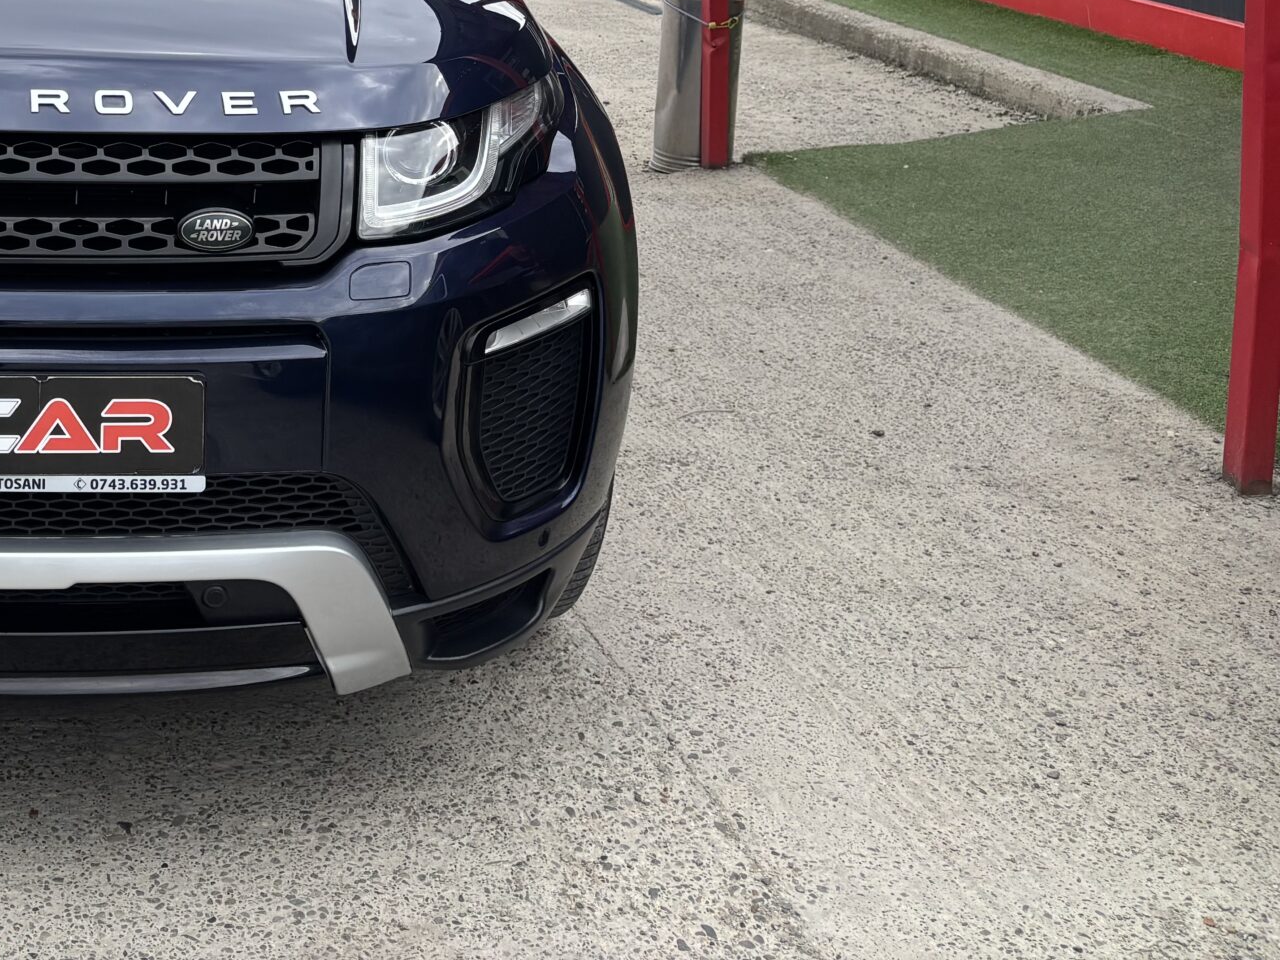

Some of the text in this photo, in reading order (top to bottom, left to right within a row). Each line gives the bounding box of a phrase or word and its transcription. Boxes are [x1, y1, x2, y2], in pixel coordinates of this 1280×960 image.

[29, 89, 322, 116] ROVER
[194, 219, 231, 230] LAND
[197, 230, 242, 241] ROVER
[90, 478, 188, 491] 0743.639.931
